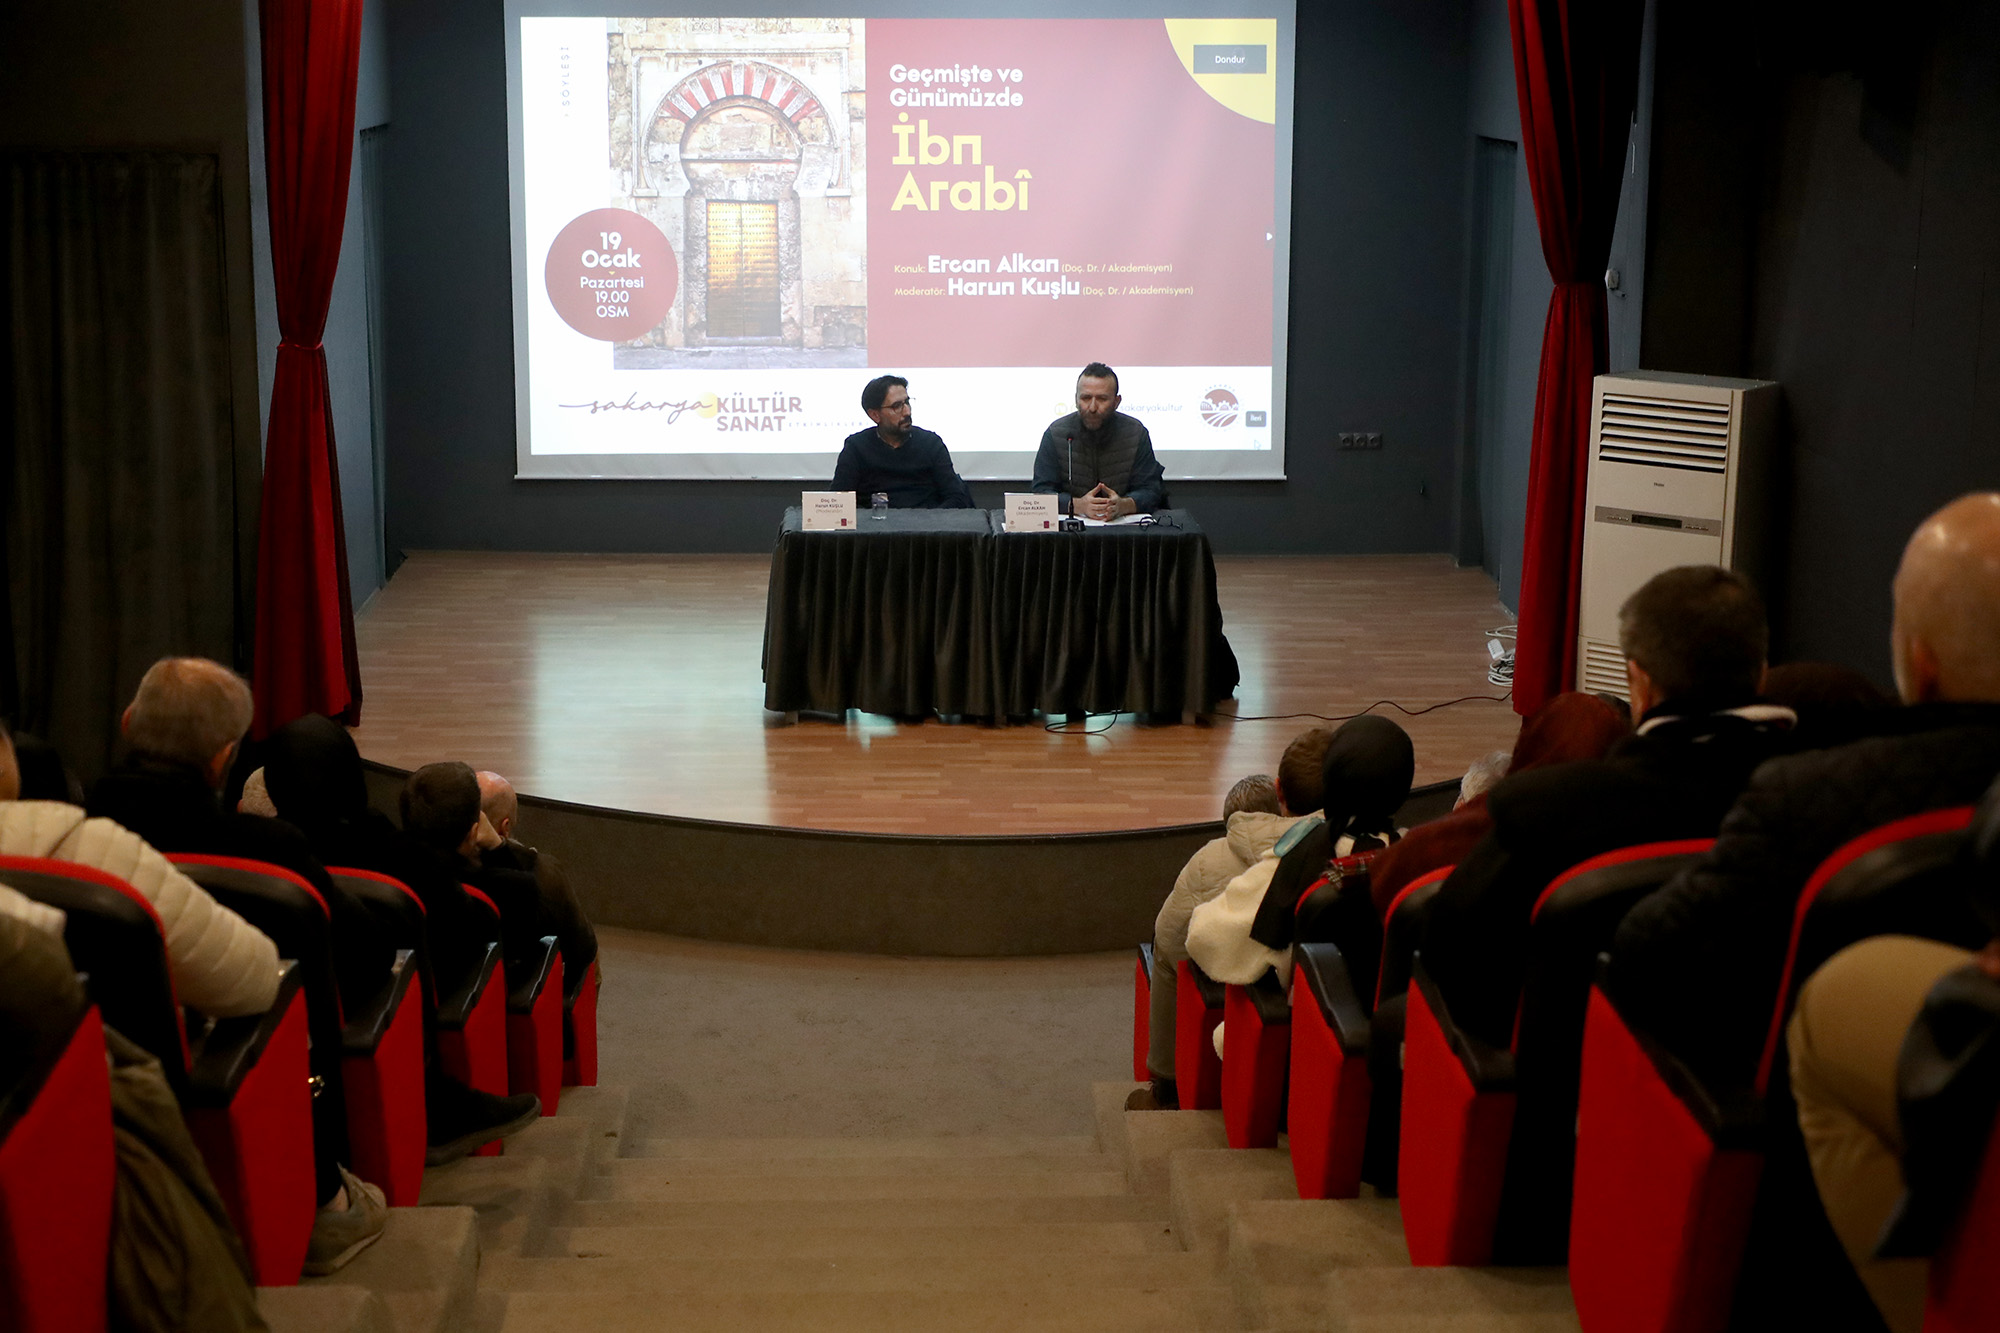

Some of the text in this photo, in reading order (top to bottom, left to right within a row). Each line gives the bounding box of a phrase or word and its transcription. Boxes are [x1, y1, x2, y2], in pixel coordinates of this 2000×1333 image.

[1215, 55, 1246, 64] Dondur
[889, 63, 1024, 88] Geçmişte ve
[889, 86, 1024, 107] Günümüzde
[892, 111, 982, 166] İbn
[890, 165, 1033, 211] Arabî
[599, 231, 622, 251] 19
[581, 247, 642, 269] Ocak
[894, 264, 926, 274] Konuk:
[927, 254, 990, 274] Ercan
[996, 252, 1060, 274] Alkan
[1061, 263, 1085, 275] (Doç.
[1086, 264, 1100, 273] Dr.
[1107, 263, 1173, 275] Akademisyen)
[580, 276, 645, 289] Pazartesi
[894, 286, 946, 296] Moderatör:
[947, 277, 1015, 296] Harun
[1021, 275, 1081, 300] Kuşlu
[1082, 286, 1107, 297] (Doç.
[1108, 287, 1121, 296] Dr.
[1128, 286, 1194, 297] Akademisyen)
[595, 290, 630, 304] 19.00
[596, 305, 630, 318] OSM
[558, 391, 803, 425] sakarya KÜLTÜR
[716, 415, 787, 432] SANAT
